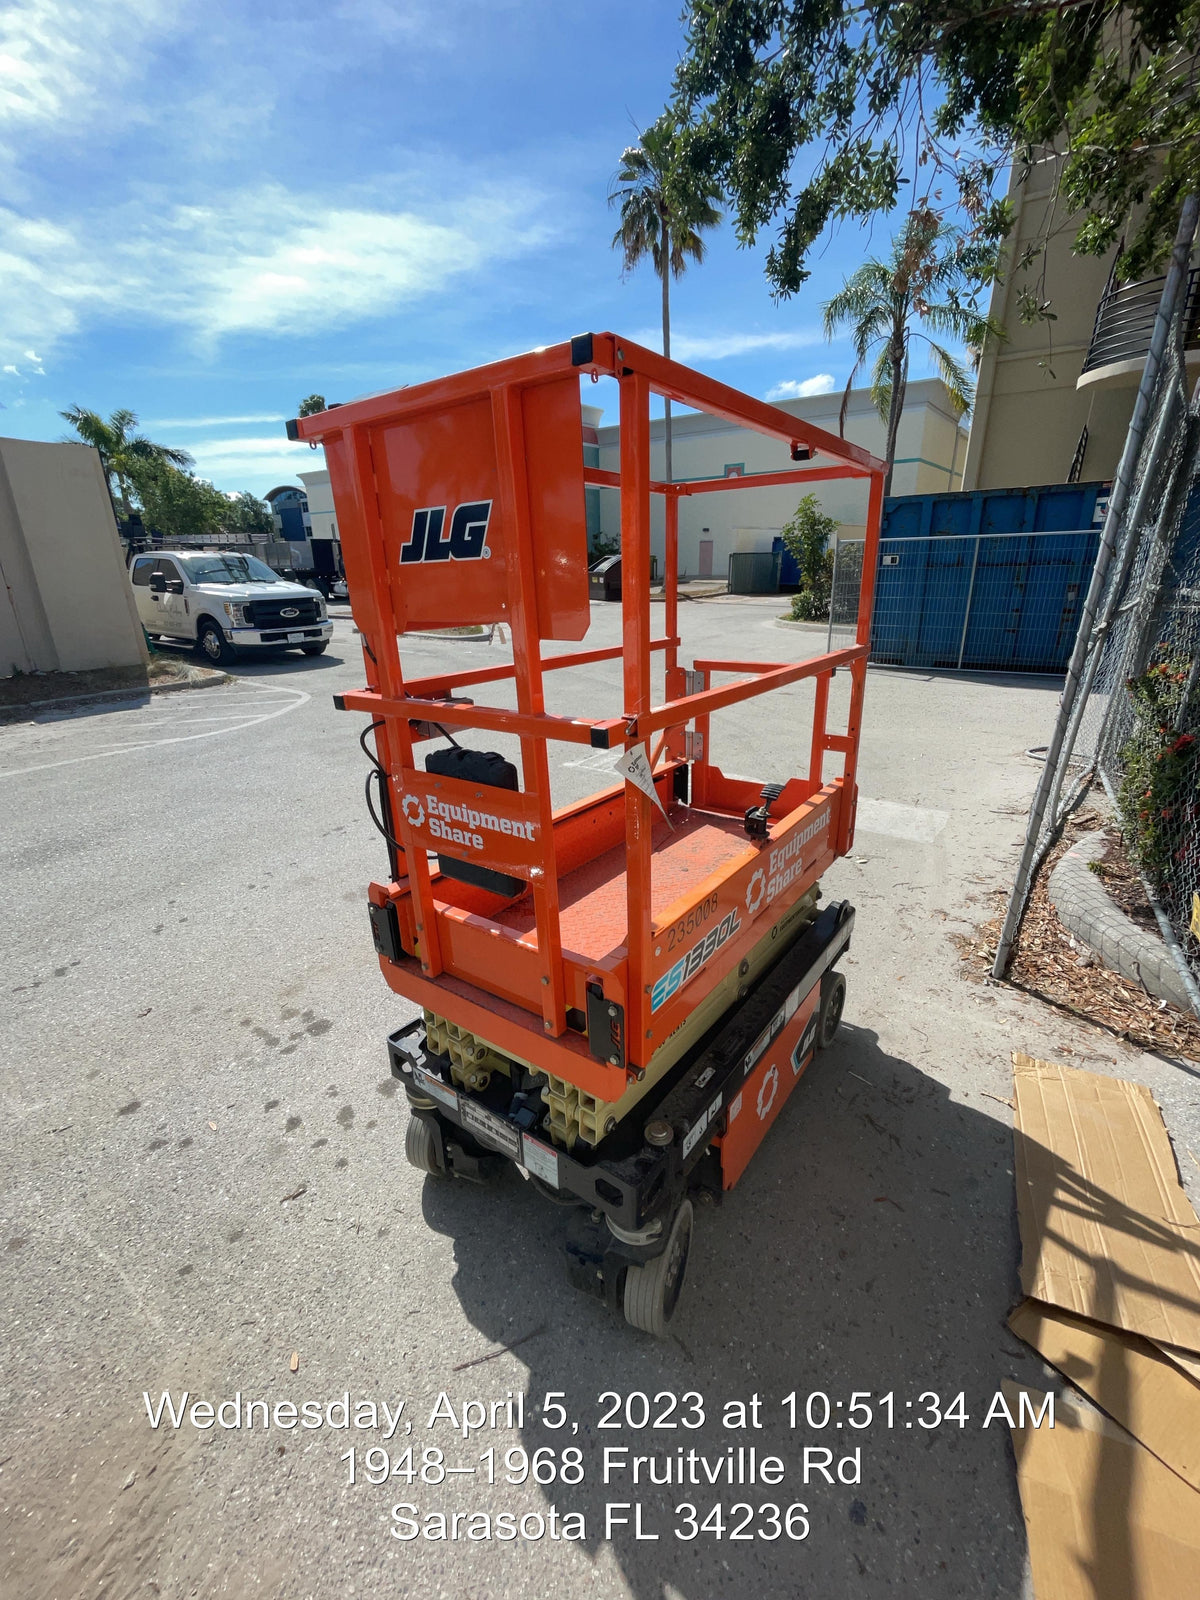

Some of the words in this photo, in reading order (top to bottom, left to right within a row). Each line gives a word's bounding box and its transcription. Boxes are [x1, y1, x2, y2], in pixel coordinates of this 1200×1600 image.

[399, 499, 493, 565] JLG
[426, 794, 535, 842] Equipment
[429, 817, 484, 850] Share
[769, 807, 831, 874] Equipment
[766, 858, 802, 902] Share
[667, 892, 718, 953] 235008
[651, 906, 742, 1015] ES1330L
